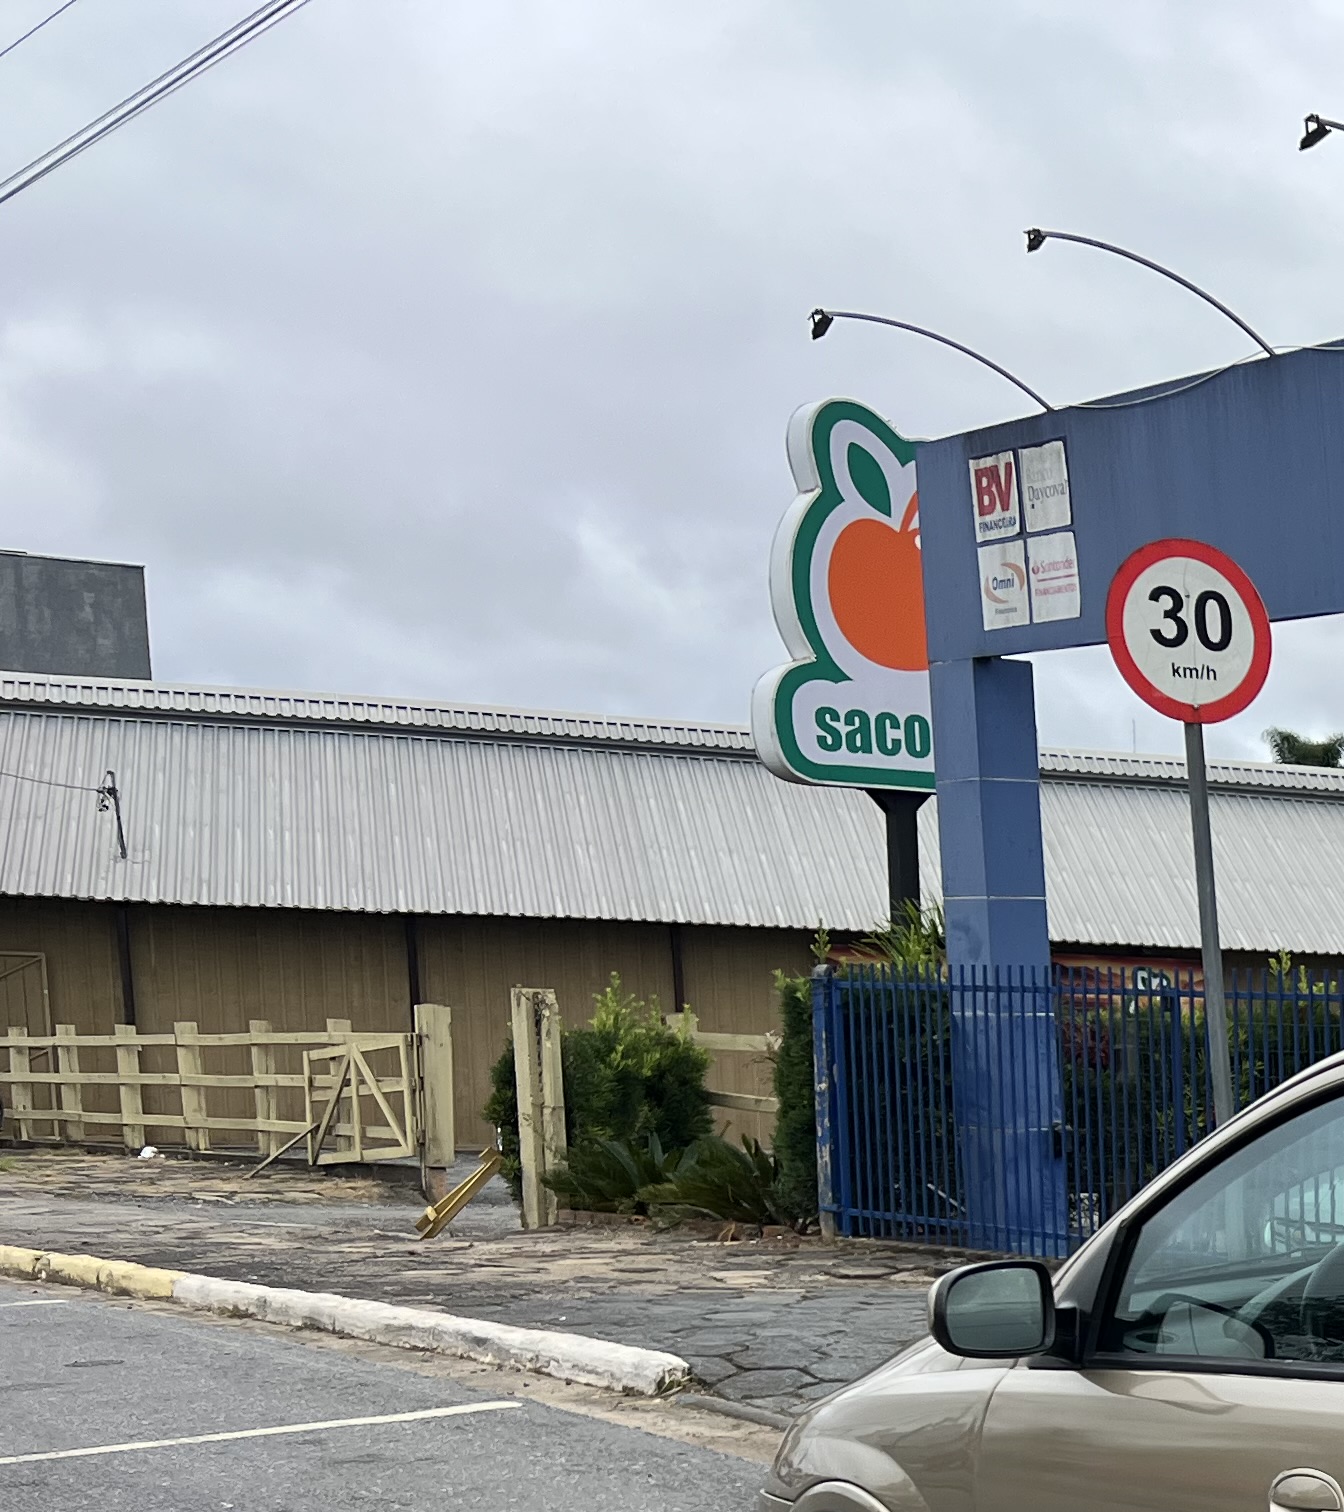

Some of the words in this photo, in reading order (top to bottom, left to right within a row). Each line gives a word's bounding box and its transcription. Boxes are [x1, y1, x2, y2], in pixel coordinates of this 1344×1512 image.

[975, 461, 1013, 517] BV
[1028, 479, 1068, 504] Daycoval
[979, 516, 1017, 533] FINANCEIRA
[992, 572, 1015, 591] Omni
[1148, 585, 1233, 652] 30
[1171, 660, 1217, 682] km/h
[815, 706, 931, 759] saco
